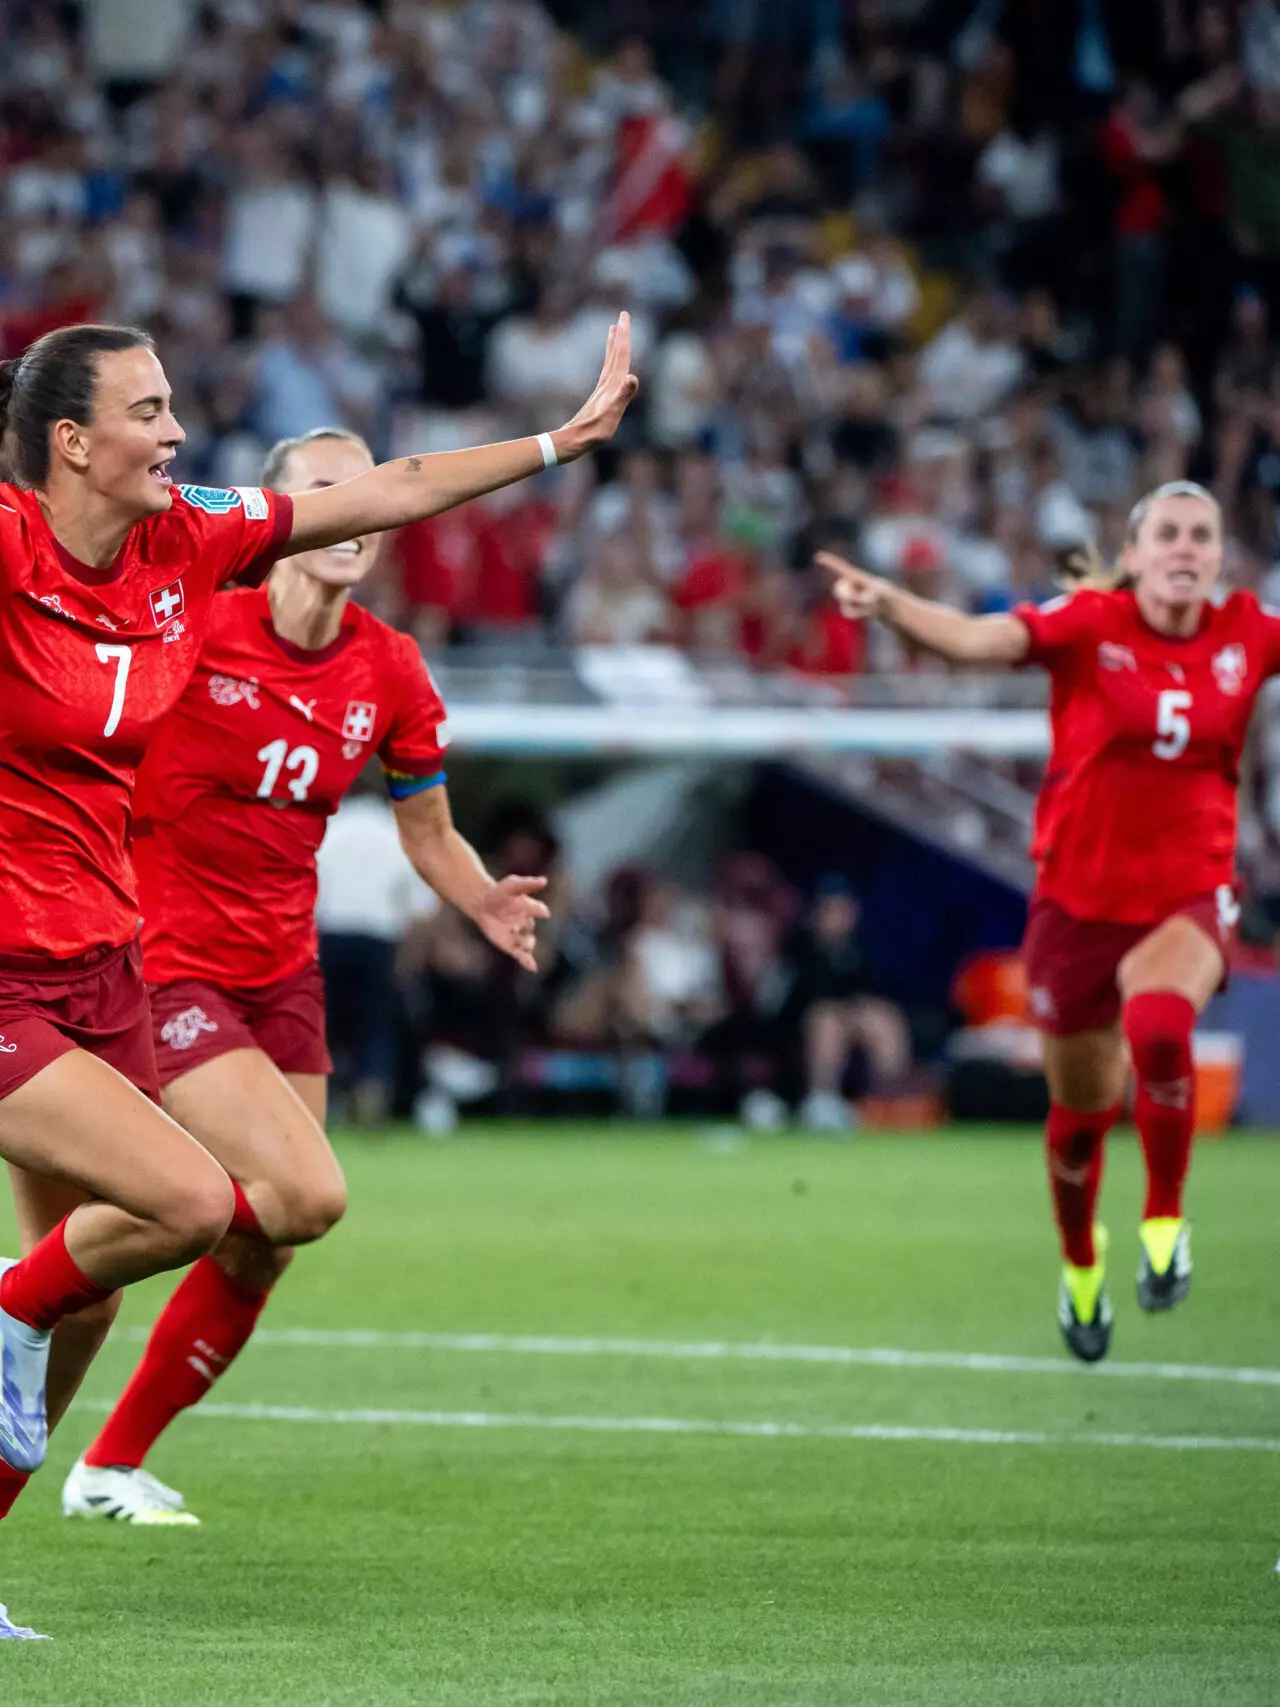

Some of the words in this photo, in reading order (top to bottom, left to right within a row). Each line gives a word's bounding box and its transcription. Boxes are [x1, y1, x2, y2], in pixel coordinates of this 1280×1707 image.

[95, 643, 132, 737] 7
[1152, 689, 1193, 760] 5
[257, 739, 319, 804] 13
